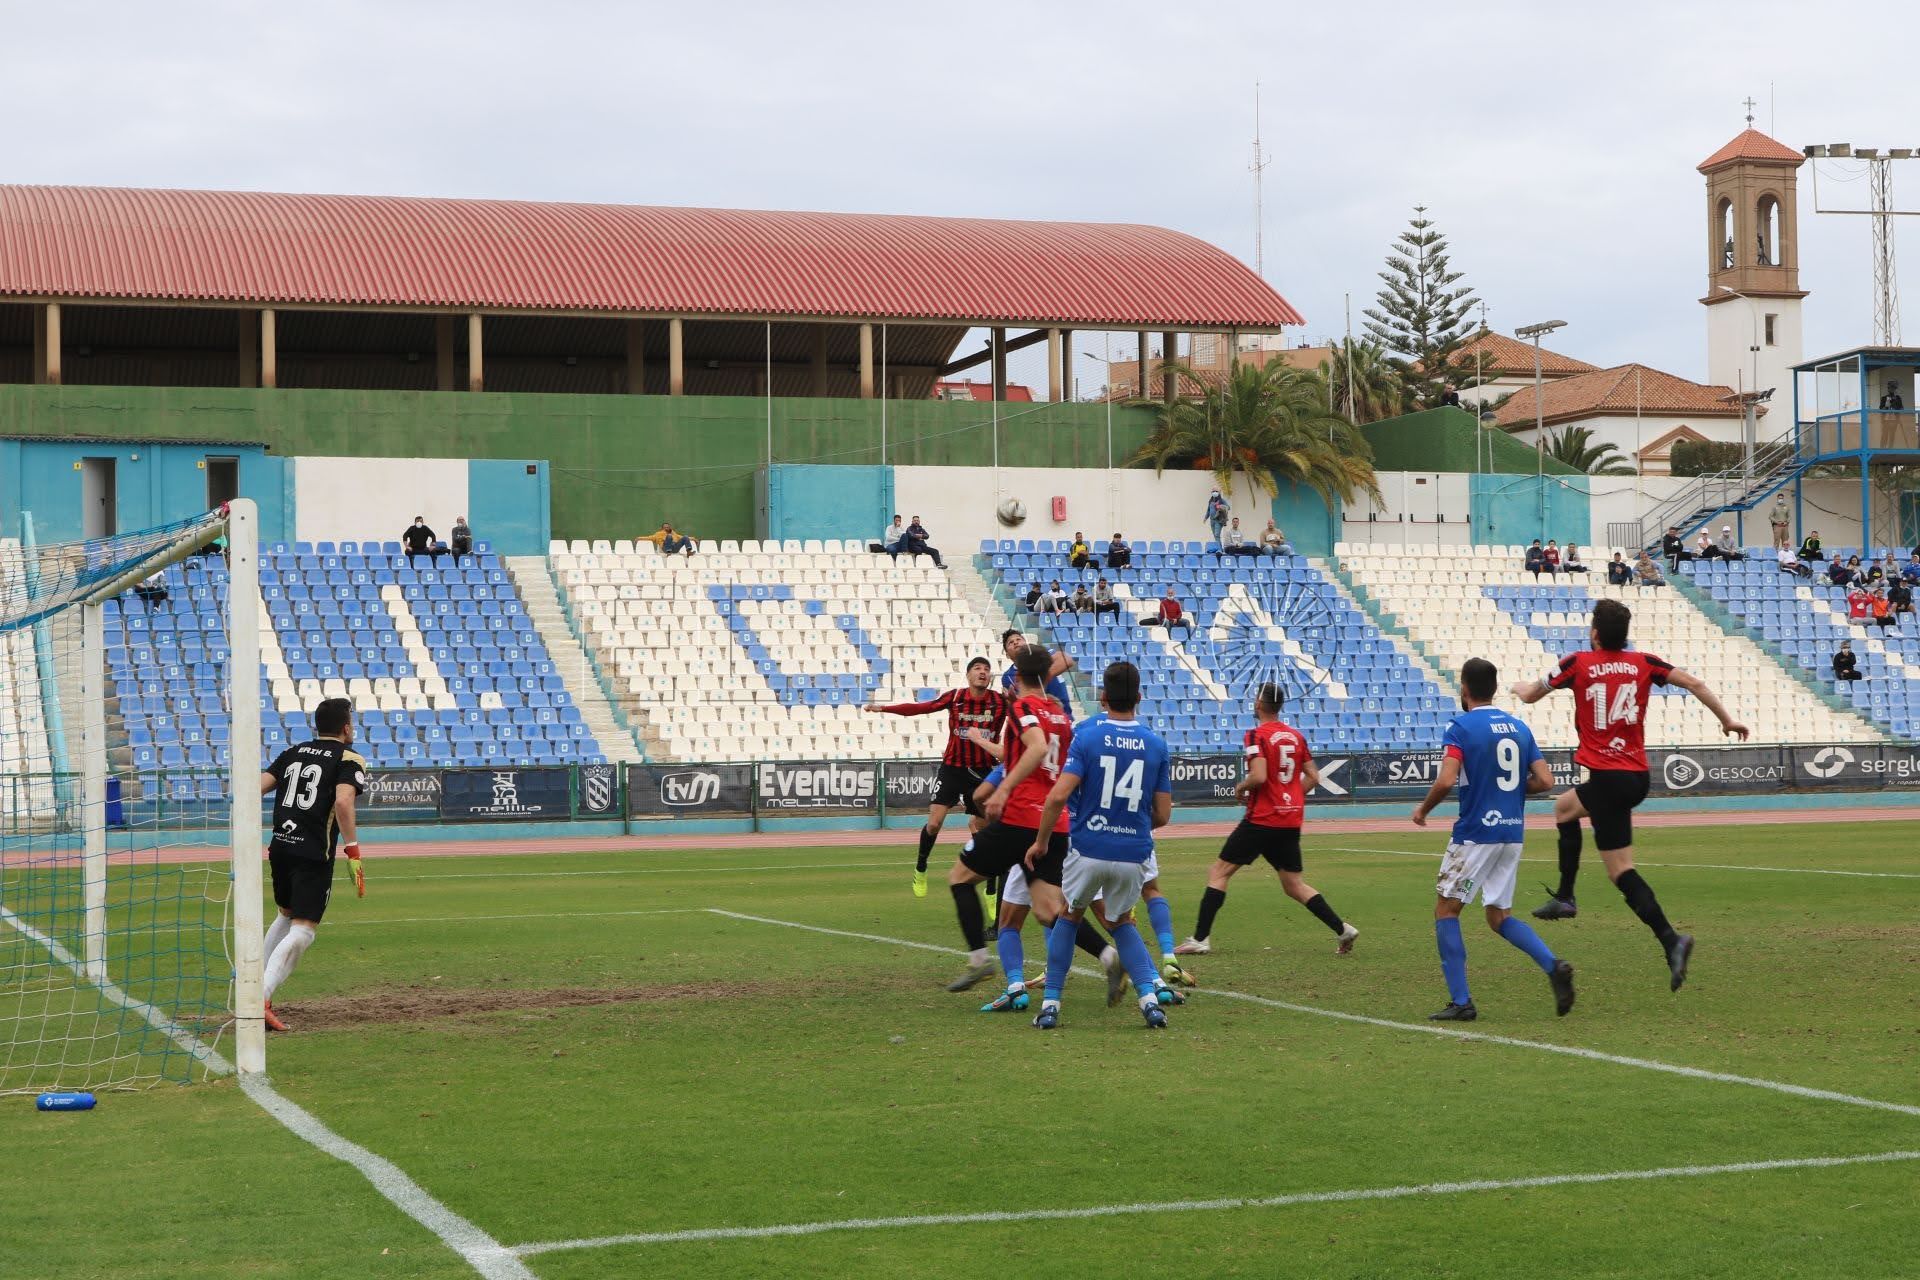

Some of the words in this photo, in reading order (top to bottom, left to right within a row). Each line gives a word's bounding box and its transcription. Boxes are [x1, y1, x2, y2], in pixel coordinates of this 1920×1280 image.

[1585, 680, 1640, 731] 14
[1104, 734, 1114, 747] S.
[1116, 736, 1145, 751] CHICA
[1489, 723, 1509, 734] IKER
[1040, 732, 1061, 781] 4
[1277, 744, 1296, 784] 5
[1495, 737, 1520, 792] 9
[1708, 766, 1786, 780] GESOCAT
[281, 761, 323, 811] 13
[758, 763, 876, 797] Eventos
[1099, 755, 1145, 813] 14
[1214, 784, 1236, 797] Roca
[382, 793, 432, 803] ESPAÑOLA
[1102, 823, 1137, 835] serglobin
